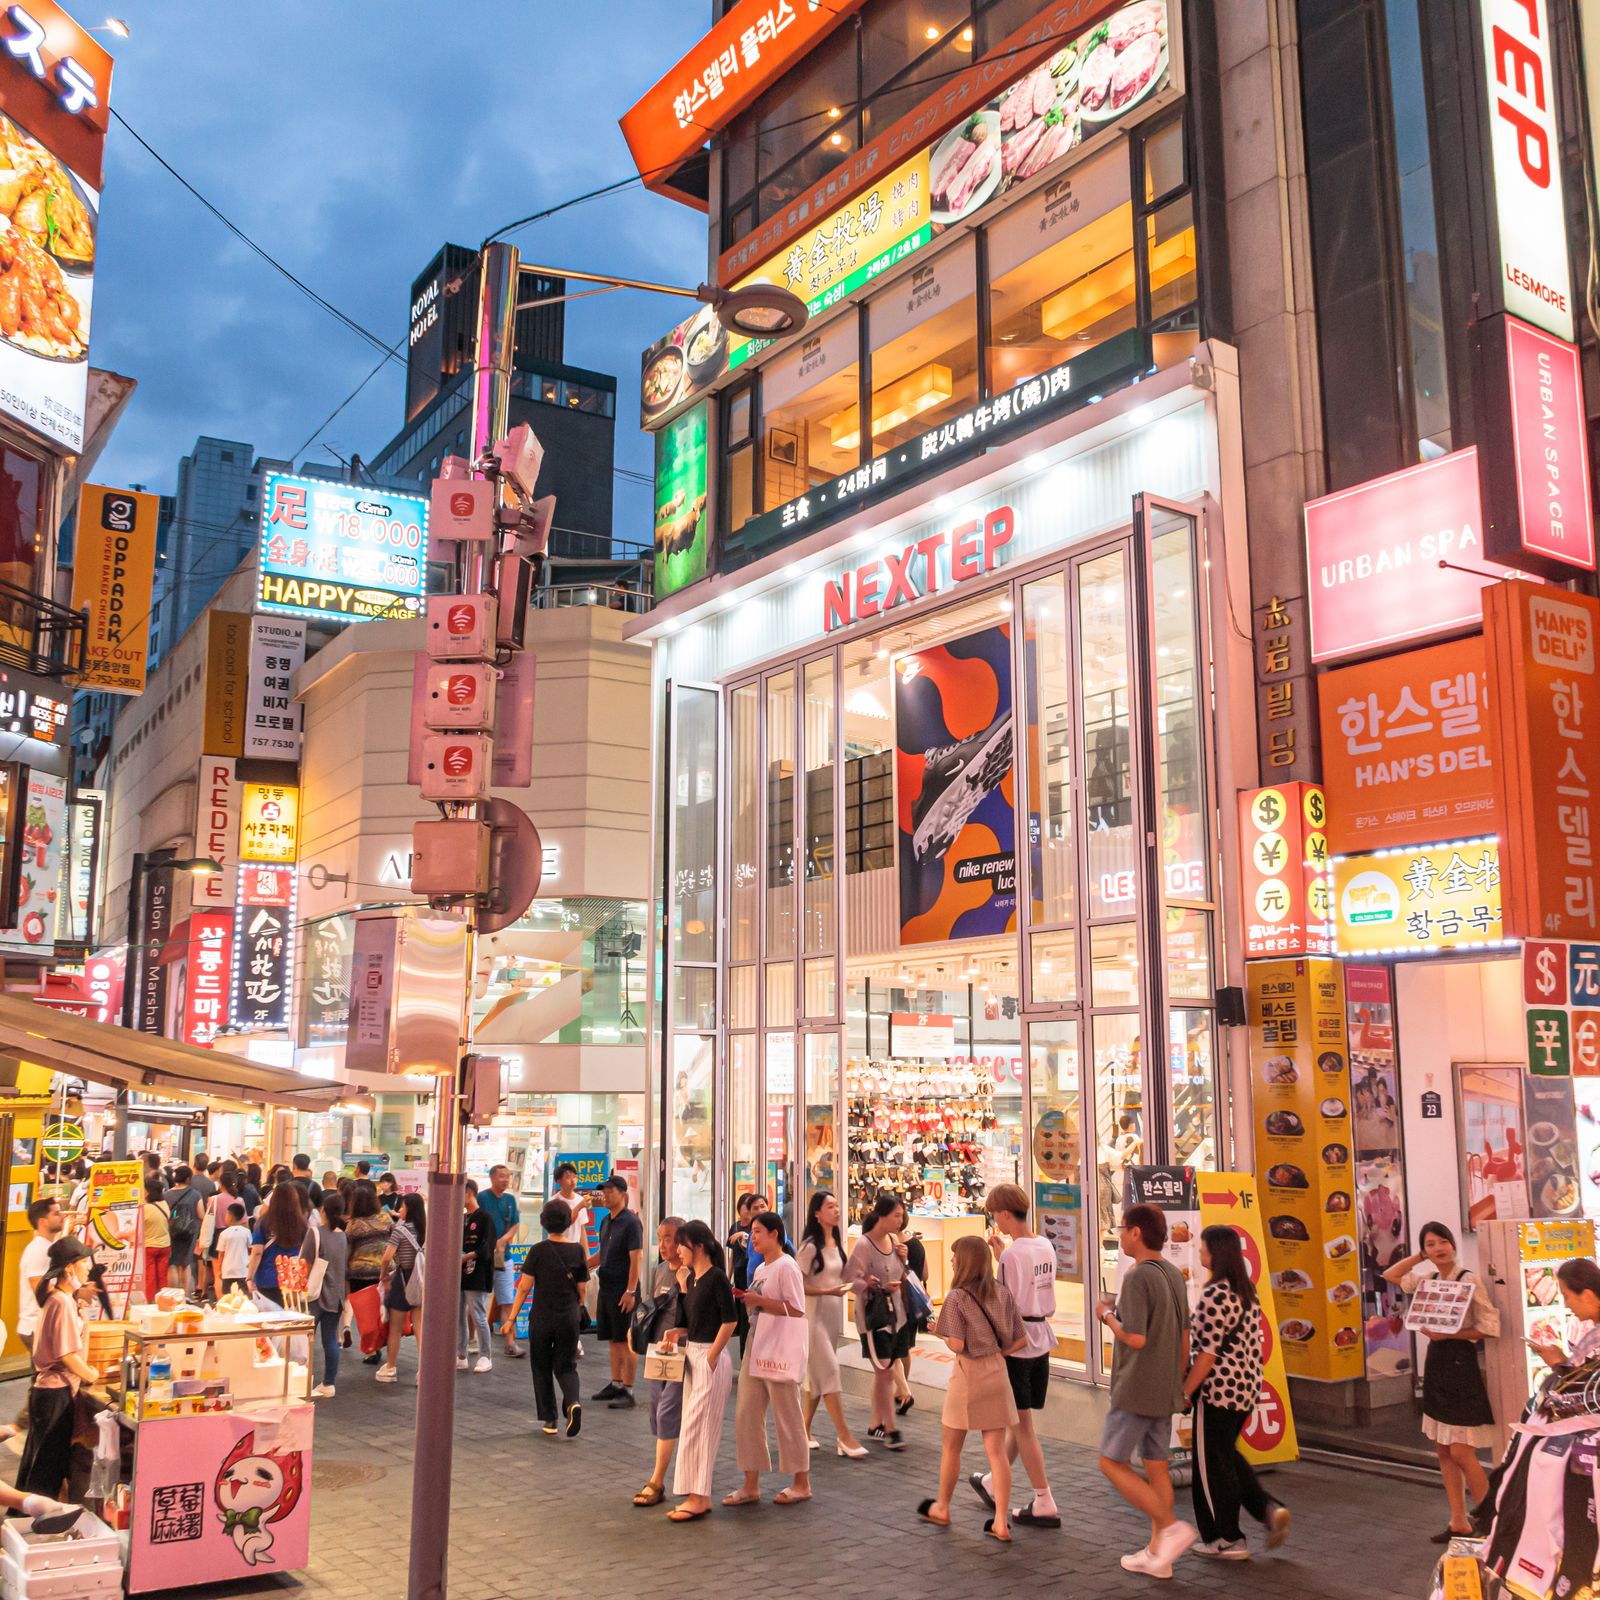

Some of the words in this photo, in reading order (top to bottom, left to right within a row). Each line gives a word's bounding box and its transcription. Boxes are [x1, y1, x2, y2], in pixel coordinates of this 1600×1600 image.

[673, 44, 740, 129] 한스델리
[1505, 263, 1567, 313] LESMORE
[410, 279, 440, 324] ROYAL
[409, 303, 439, 347] HOTEL
[1538, 352, 1557, 440] URBAN
[1544, 448, 1565, 540] SPACE
[269, 484, 308, 530] 足
[782, 496, 811, 529] 主食
[823, 505, 1016, 634] NEXTEP
[1321, 540, 1412, 589] URBAN
[107, 537, 129, 645] OPPADAK
[263, 575, 355, 612] HAPPY
[1535, 608, 1588, 642] HAN'S
[113, 648, 143, 663] OUT
[264, 655, 292, 672] 증명
[263, 676, 291, 692] 여권
[262, 694, 290, 711] 비자
[254, 714, 295, 732] 프로필
[251, 737, 270, 748] 757
[272, 737, 295, 750] 7530
[1356, 754, 1435, 789] HAN'S
[257, 787, 285, 801] 명동
[1549, 678, 1597, 929] 한스델리
[1384, 809, 1418, 825] 스테이크
[244, 822, 295, 840] 사주카페
[280, 846, 295, 857] 3F
[959, 861, 981, 879] nike
[982, 857, 1014, 875] renew
[150, 885, 166, 931] Salon
[1262, 889, 1285, 912] 元
[1545, 912, 1562, 933] 4F
[149, 936, 160, 959] de
[1535, 946, 1557, 996] $
[1573, 952, 1600, 996] 元
[254, 1009, 269, 1020] 2F
[918, 1014, 929, 1026] 2F
[1262, 1001, 1296, 1018] 베스트
[1427, 1104, 1437, 1116] 23
[925, 1181, 943, 1201] 70
[1142, 1180, 1184, 1197] 한스델리
[1239, 1190, 1253, 1209] 1F
[1245, 1391, 1281, 1437] 元
